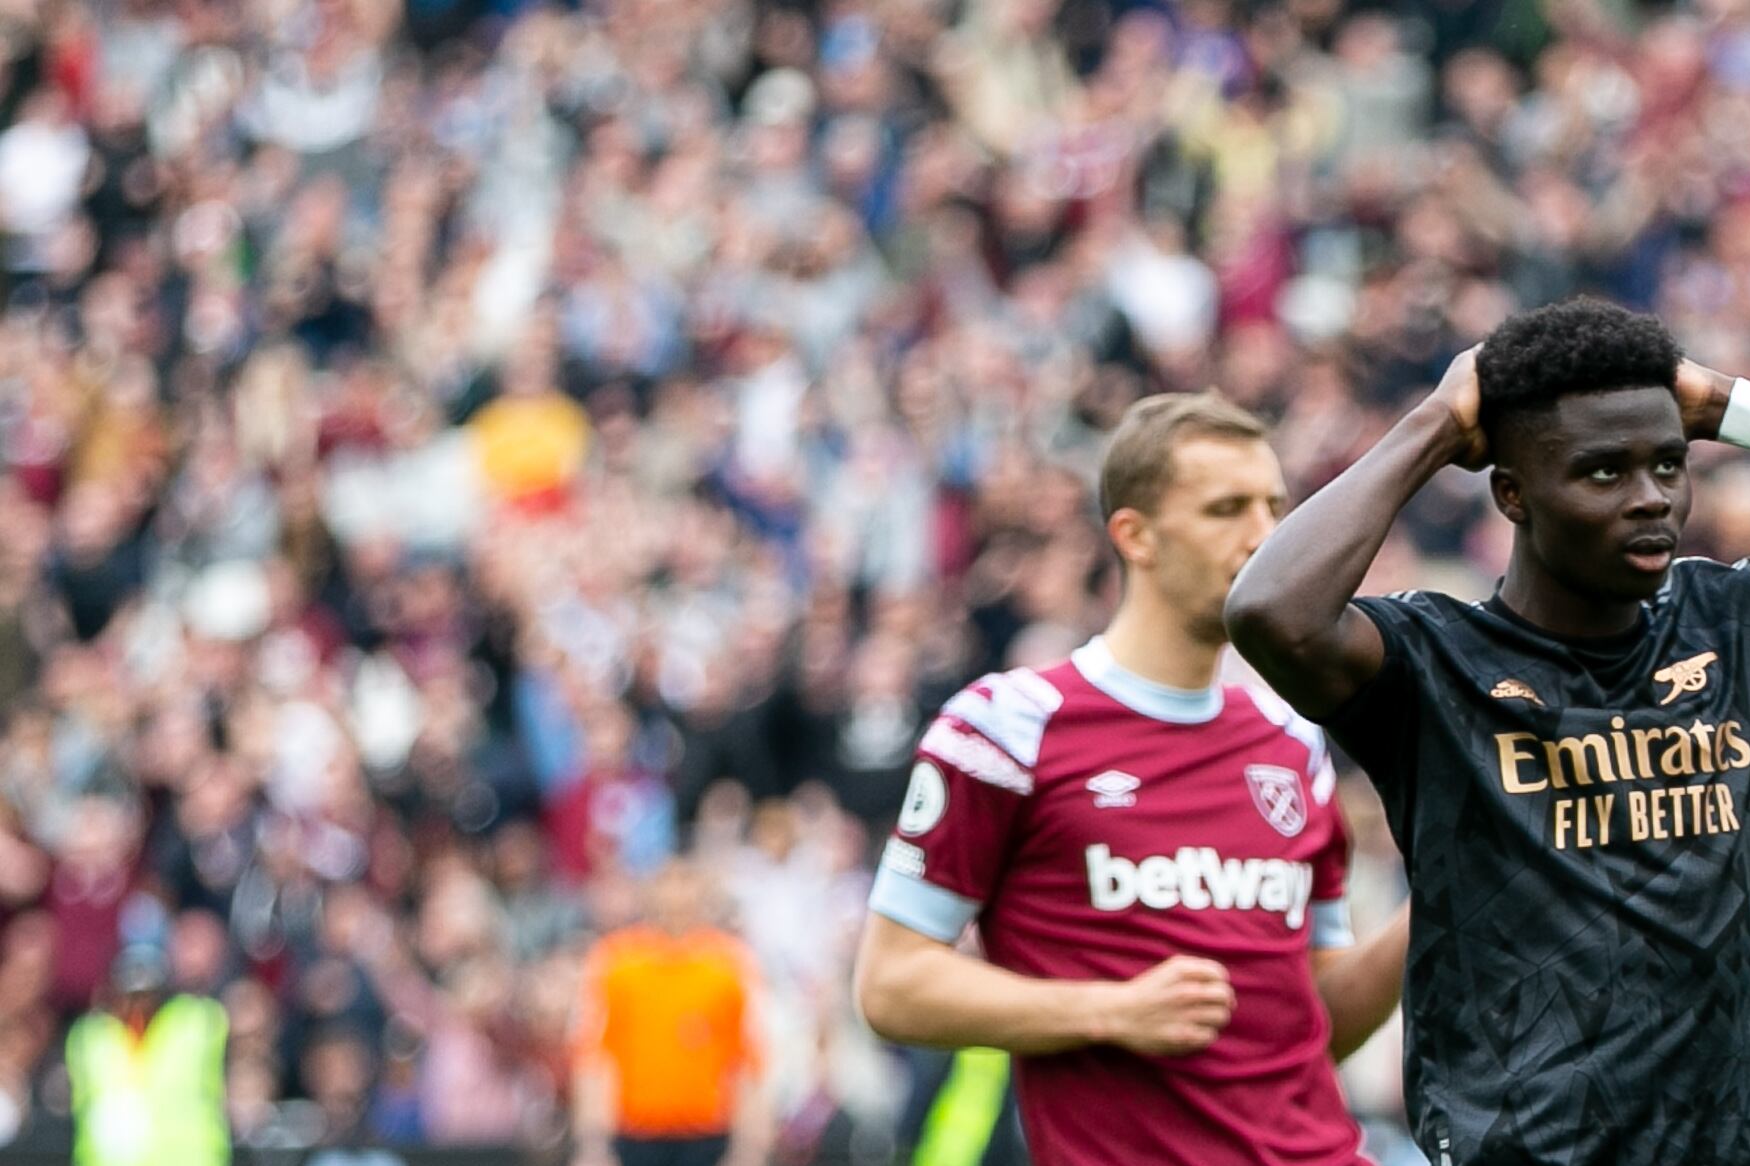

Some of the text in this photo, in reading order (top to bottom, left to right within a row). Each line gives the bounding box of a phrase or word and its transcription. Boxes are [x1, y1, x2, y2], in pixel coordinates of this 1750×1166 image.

[1554, 783, 1741, 850] FLY BETTER
[1085, 843, 1312, 930] betway
